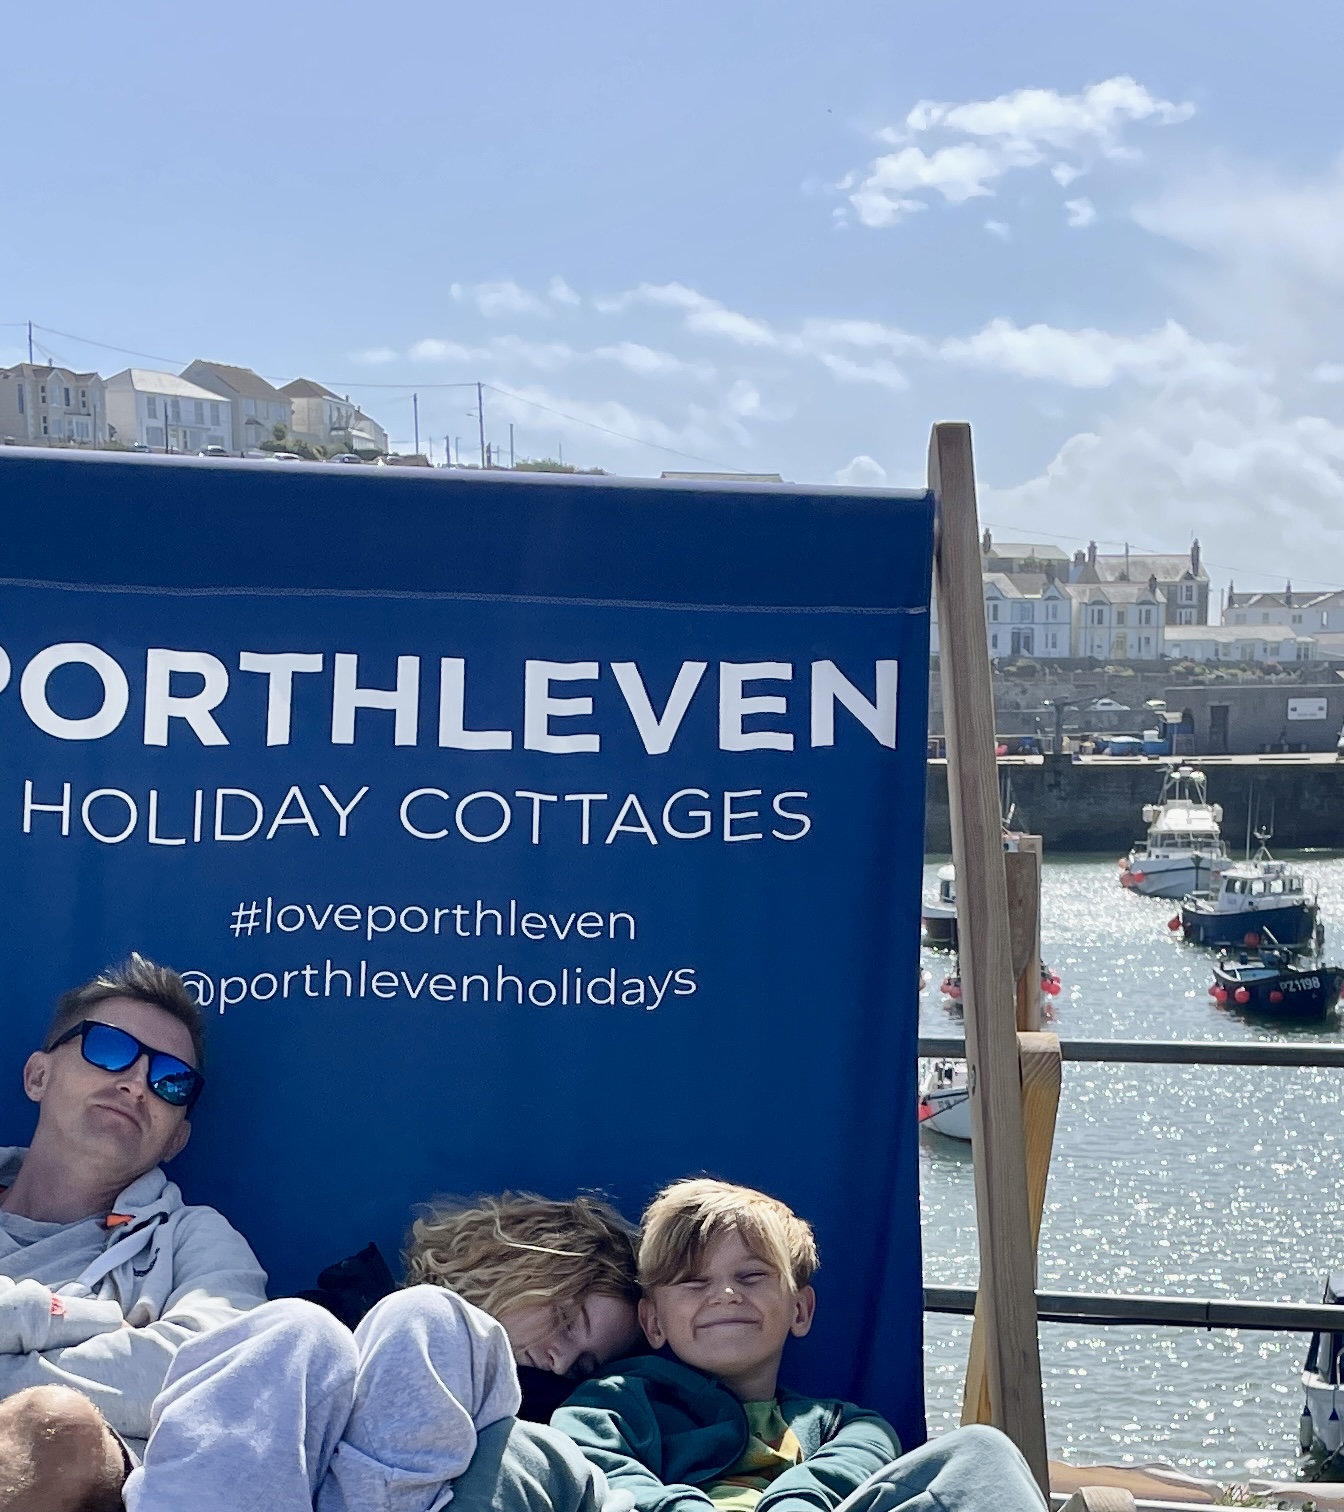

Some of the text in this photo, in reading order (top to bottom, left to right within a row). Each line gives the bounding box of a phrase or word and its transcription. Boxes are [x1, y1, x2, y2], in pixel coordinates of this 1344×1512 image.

[23, 780, 811, 846] HOLIDAY COTTAGES
[229, 896, 635, 941] #loveporthleven
[179, 960, 697, 1015] @porthlevenholidays
[1279, 976, 1321, 993] PZ1198
